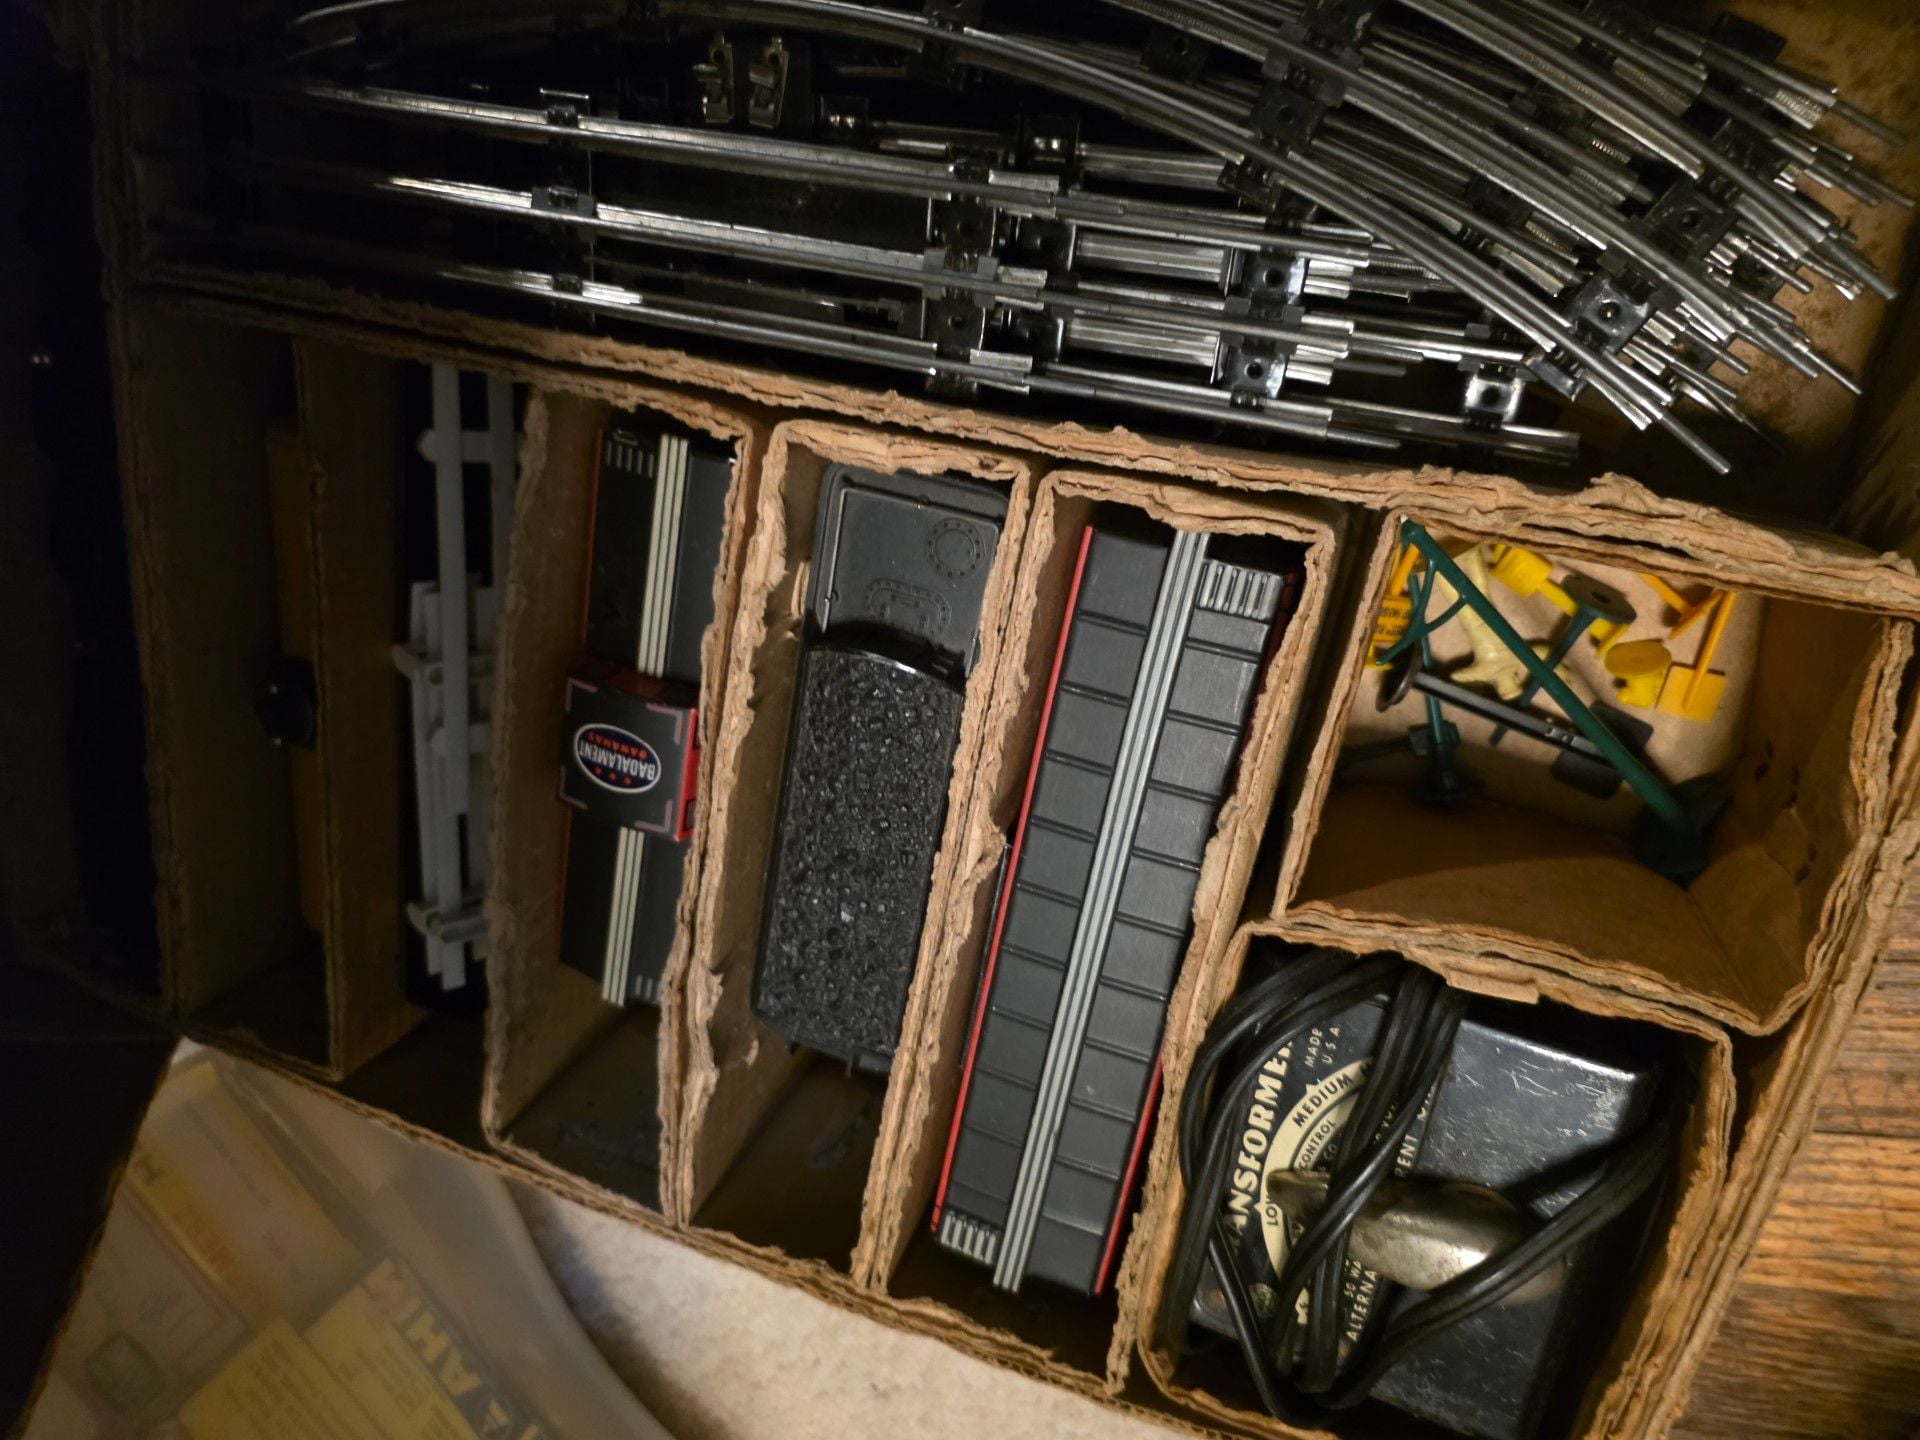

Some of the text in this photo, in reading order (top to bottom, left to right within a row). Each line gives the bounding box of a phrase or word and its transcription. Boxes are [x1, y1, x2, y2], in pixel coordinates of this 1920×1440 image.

[579, 739, 656, 781] BADALAMENT
[1303, 1027, 1323, 1068] MADE
[1292, 1073, 1353, 1128] MEDIUM
[1224, 1041, 1295, 1246] ANSFORME
[1299, 1119, 1337, 1171] CONTROL
[1346, 1269, 1377, 1343] ALTERNA
[1394, 1133, 1418, 1177] RENT
